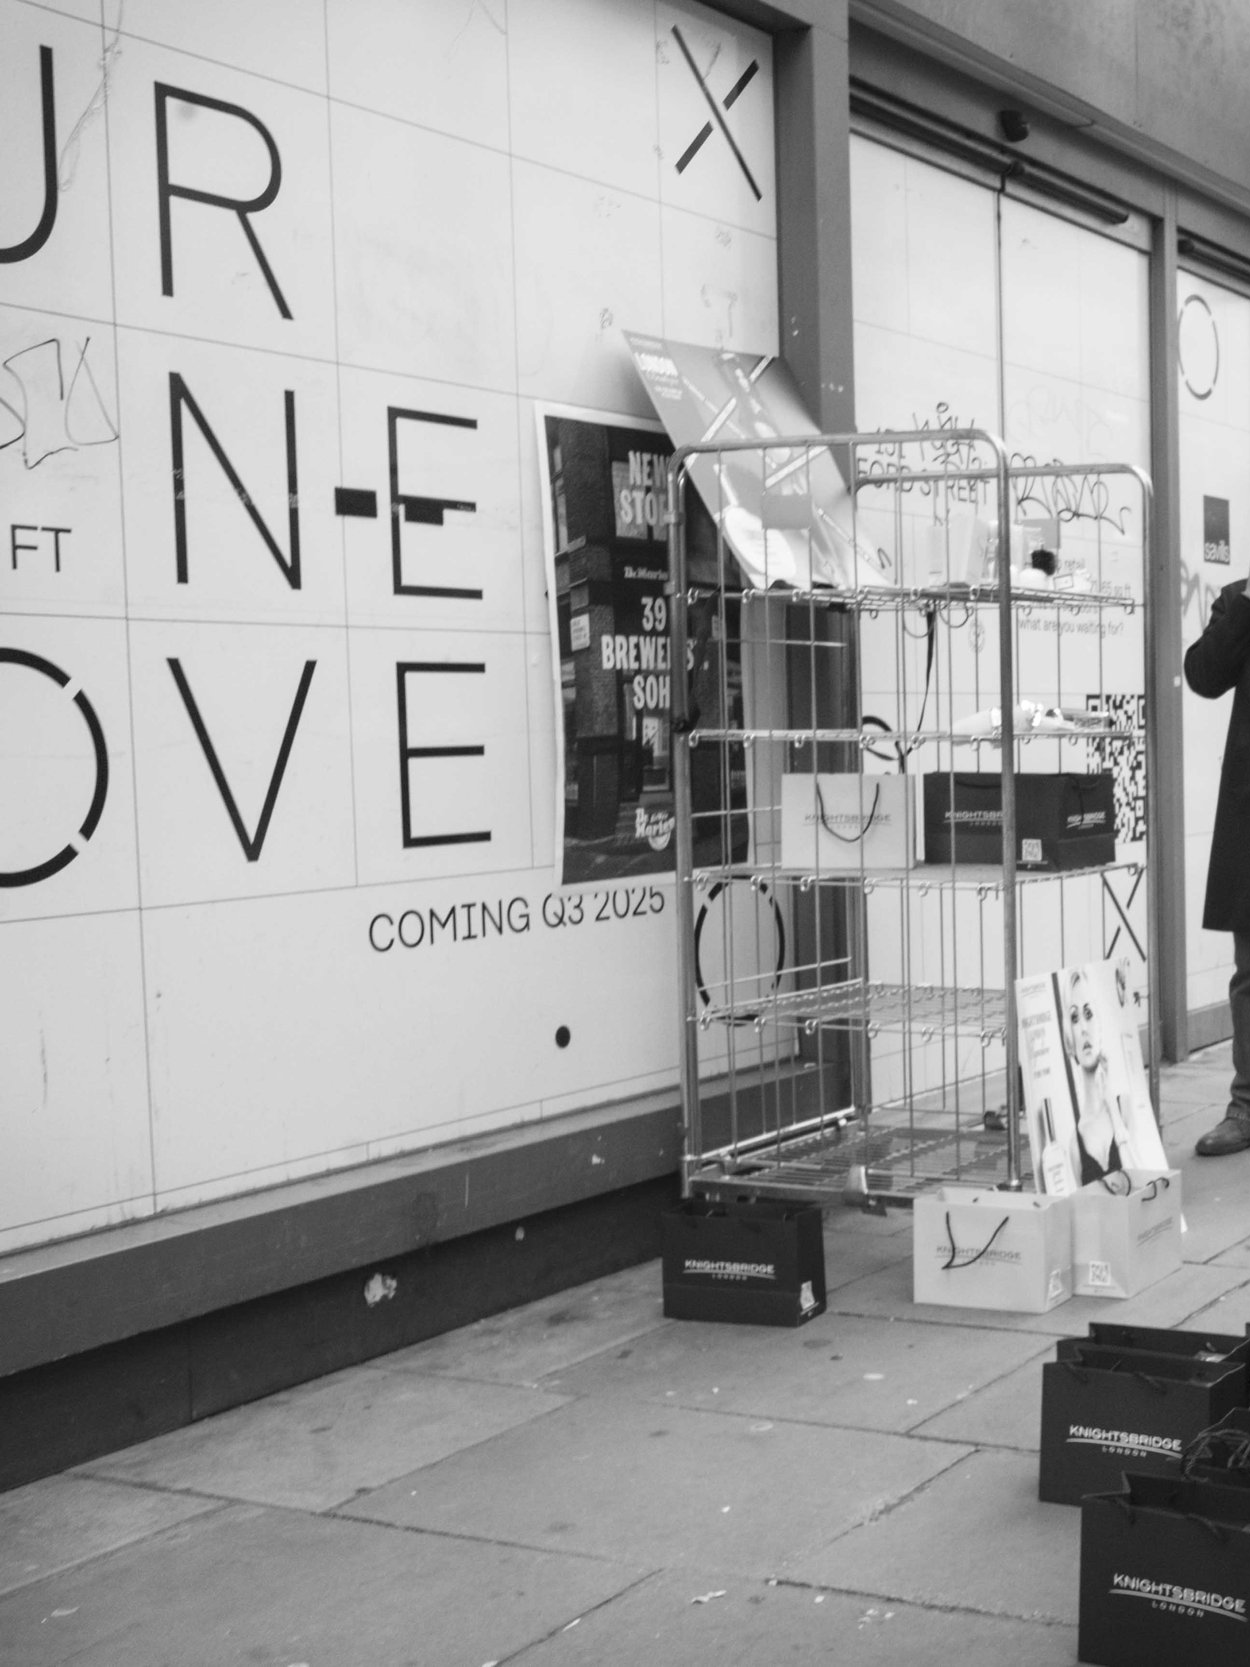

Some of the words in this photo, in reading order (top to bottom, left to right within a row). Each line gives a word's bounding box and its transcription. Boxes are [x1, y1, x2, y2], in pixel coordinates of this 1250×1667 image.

[10, 524, 72, 573] FT
[641, 597, 667, 632] 39
[601, 635, 672, 670] BREWE
[633, 675, 671, 710] SOH
[369, 898, 530, 952] COMING
[541, 892, 585, 931] Q3
[594, 886, 667, 922] 2025
[685, 1259, 775, 1275] KNIGHTSBRIDGE
[1069, 1424, 1183, 1452] KNIGHTSBRIDGE
[1112, 1572, 1246, 1613] KNIGHTSBRIDGE
